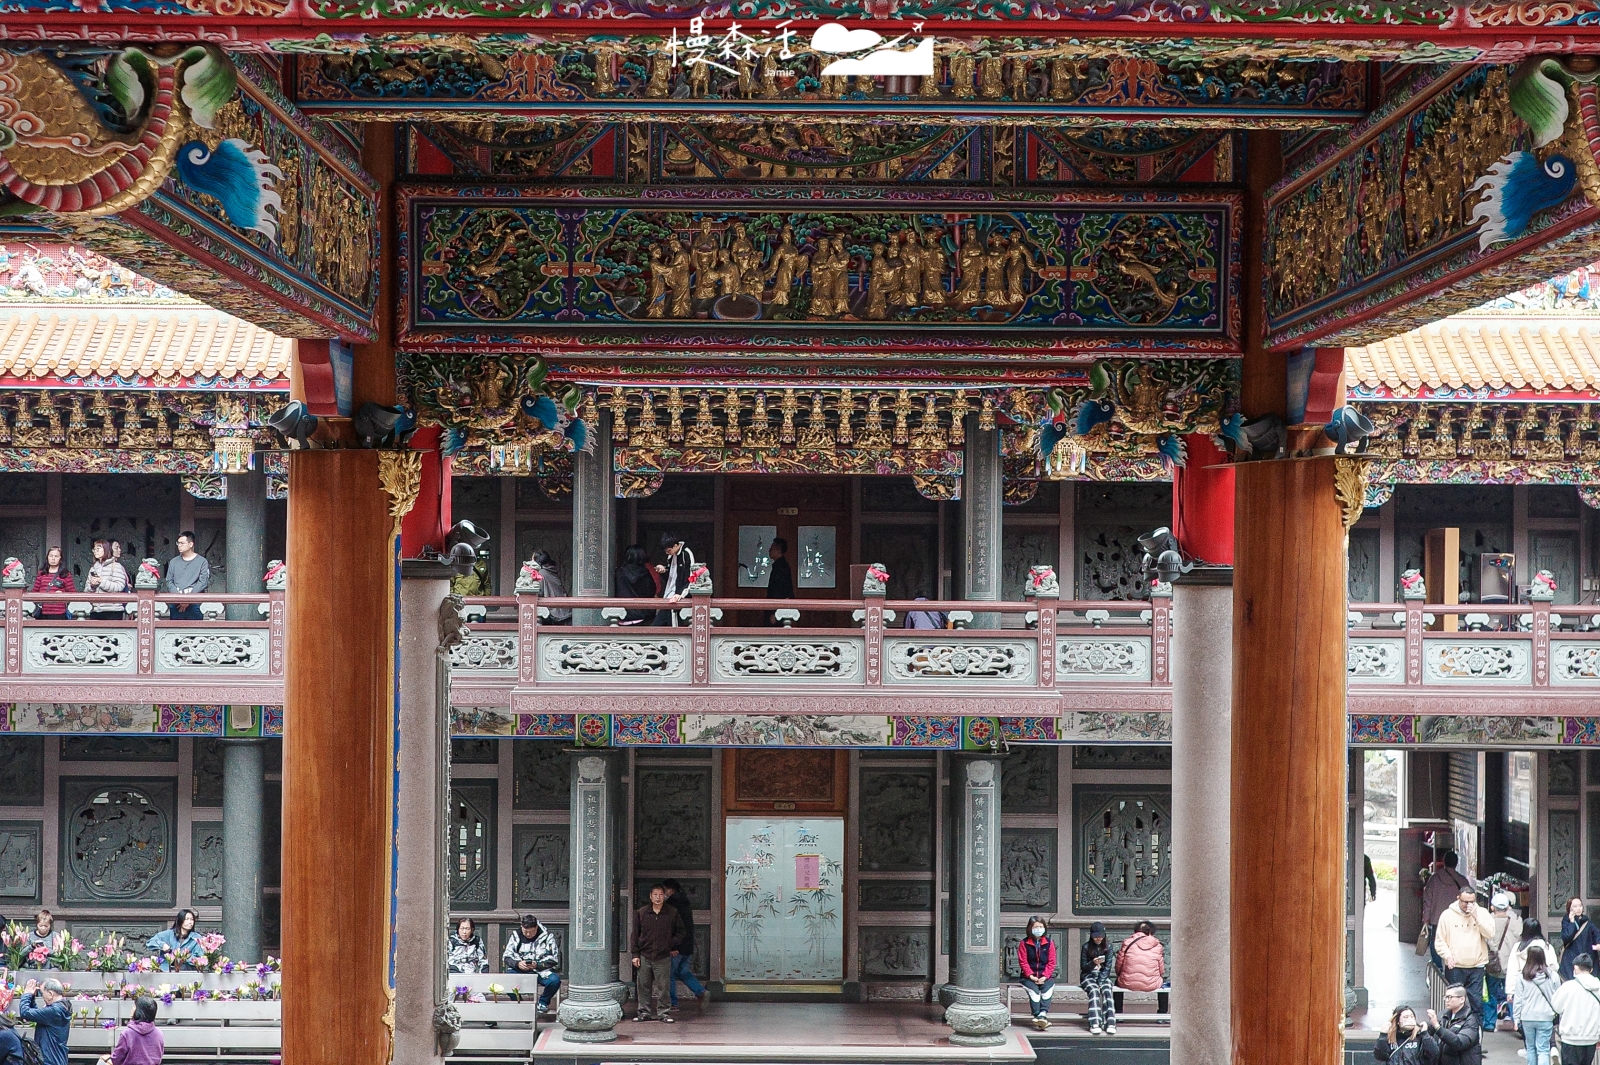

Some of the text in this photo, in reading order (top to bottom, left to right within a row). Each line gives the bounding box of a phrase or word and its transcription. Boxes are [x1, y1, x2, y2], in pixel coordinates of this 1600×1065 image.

[9, 605, 18, 667] 竹林山觀音寺
[141, 605, 151, 668] 竹林山觀音寺
[273, 607, 283, 669] 竹林山觀音寺
[523, 611, 533, 676] 竹林山觀音寺
[696, 613, 706, 677] 竹林山觀音寺
[869, 613, 879, 679] 竹林山觀音寺
[1042, 615, 1052, 681] 竹林山觀音寺
[1156, 614, 1166, 676] 竹林山觀音寺
[1410, 617, 1420, 680] 竹林山觀音寺
[1537, 618, 1547, 680] 竹林山觀音寺
